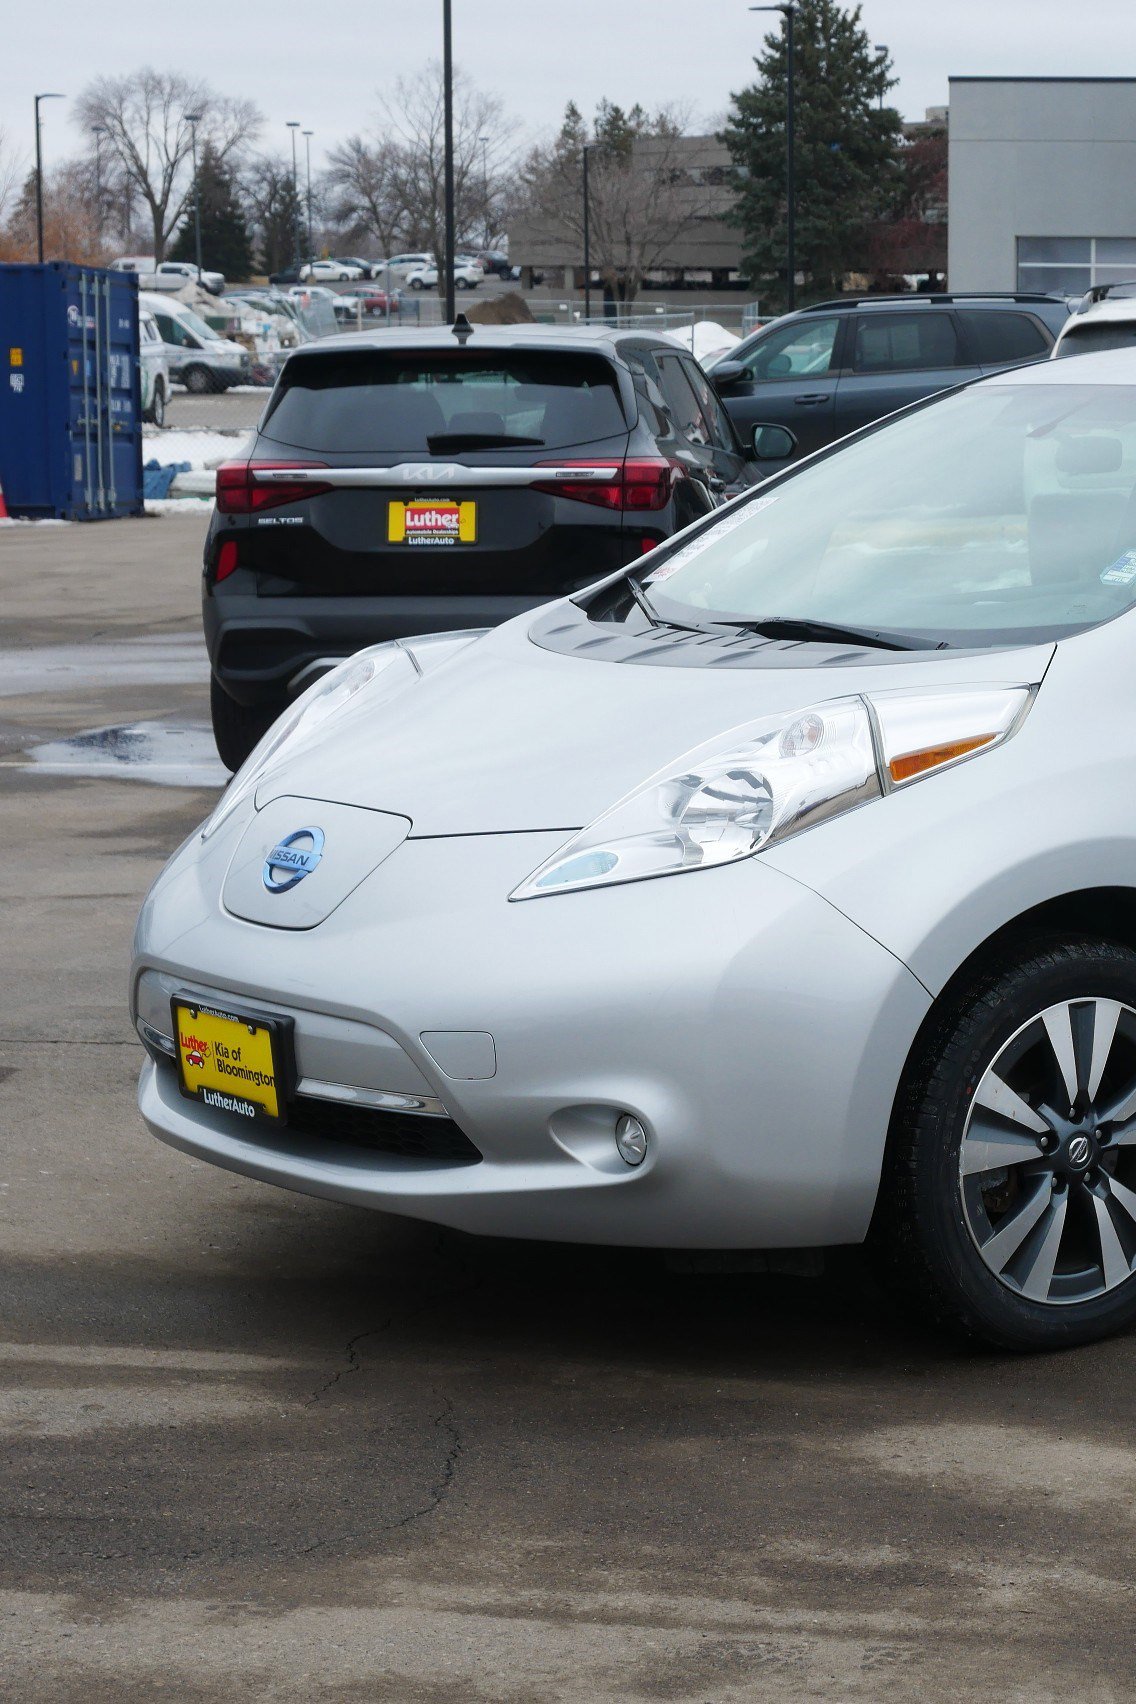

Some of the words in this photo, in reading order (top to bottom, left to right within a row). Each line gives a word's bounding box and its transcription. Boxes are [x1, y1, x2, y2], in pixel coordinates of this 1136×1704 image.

[257, 516, 304, 525] SELTOS
[405, 510, 460, 527] Luther
[409, 536, 455, 545] LutherAuto
[270, 849, 310, 866] NISSAN
[180, 1032, 209, 1053] Luther
[214, 1041, 229, 1059] Kia
[232, 1047, 241, 1061] of
[216, 1058, 275, 1087] Bloomington
[203, 1088, 255, 1117] LutherAuto
